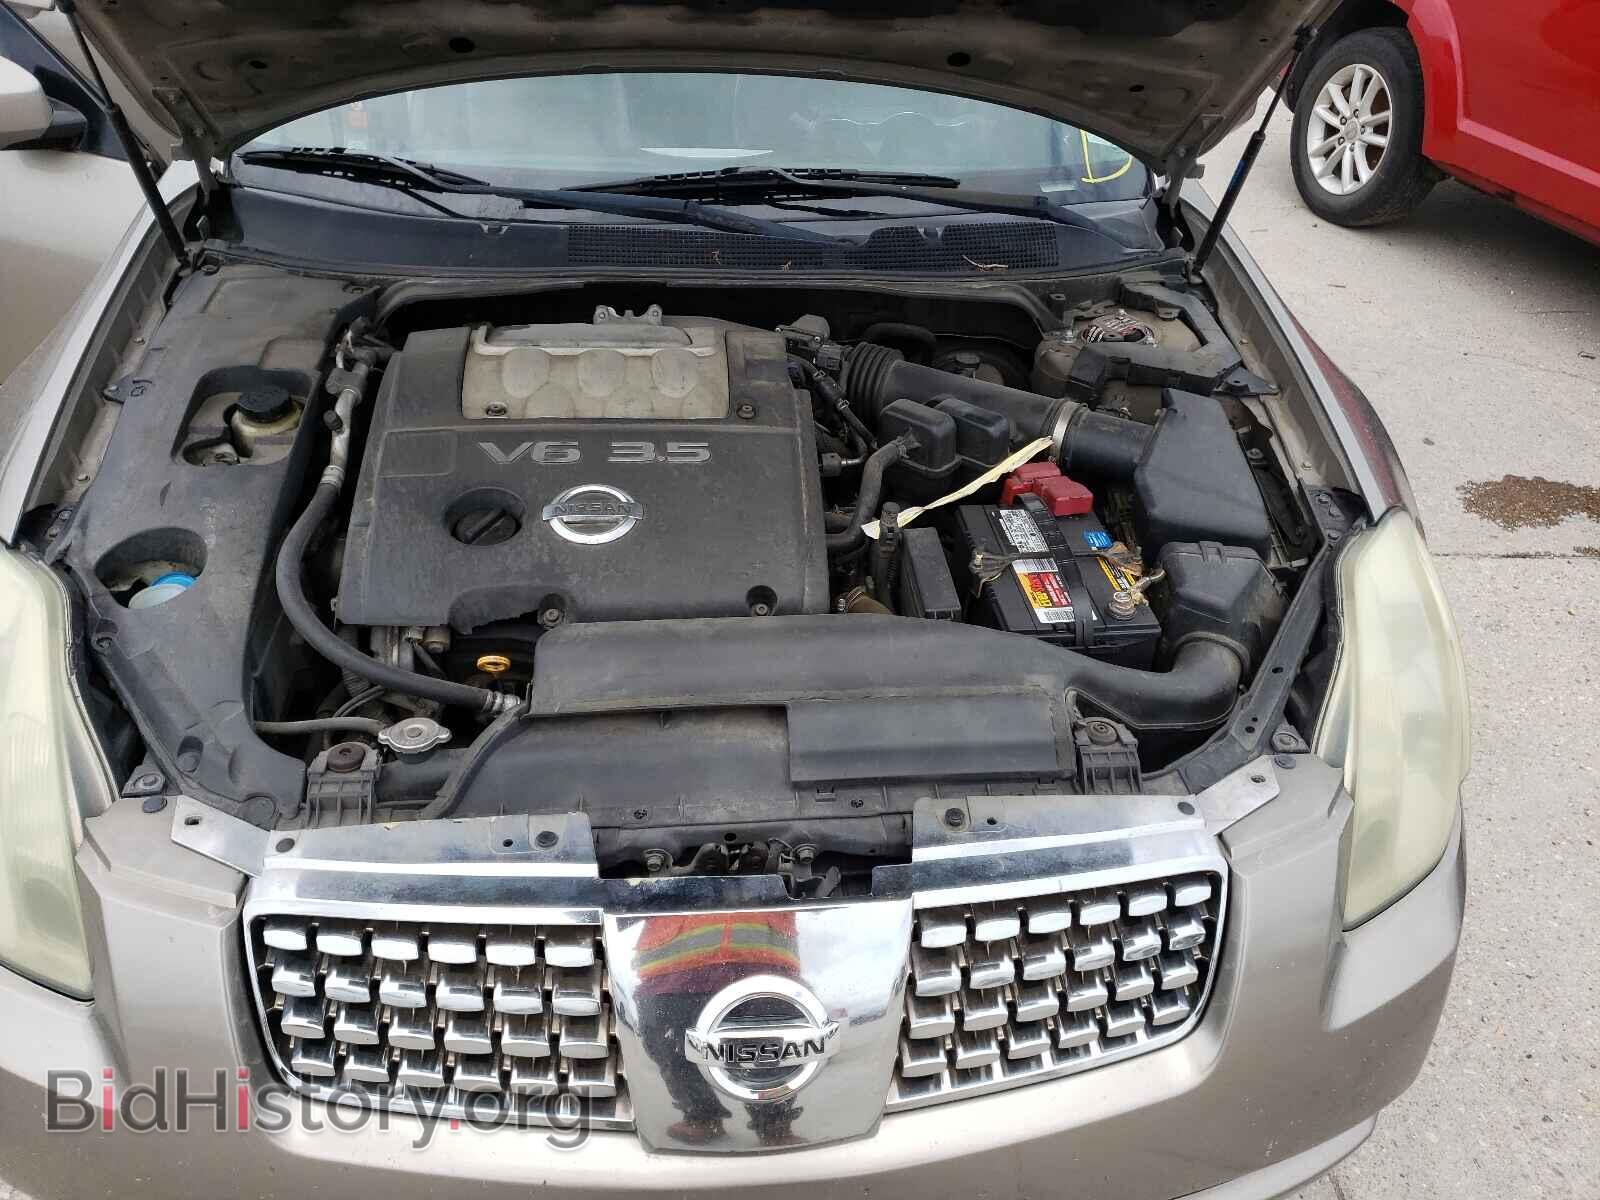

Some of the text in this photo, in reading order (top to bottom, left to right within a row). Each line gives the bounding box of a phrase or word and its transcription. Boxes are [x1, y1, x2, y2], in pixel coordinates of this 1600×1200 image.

[479, 441, 711, 464] V6 3.5
[553, 502, 633, 515] NISSAN
[703, 1038, 826, 1064] NISSAN
